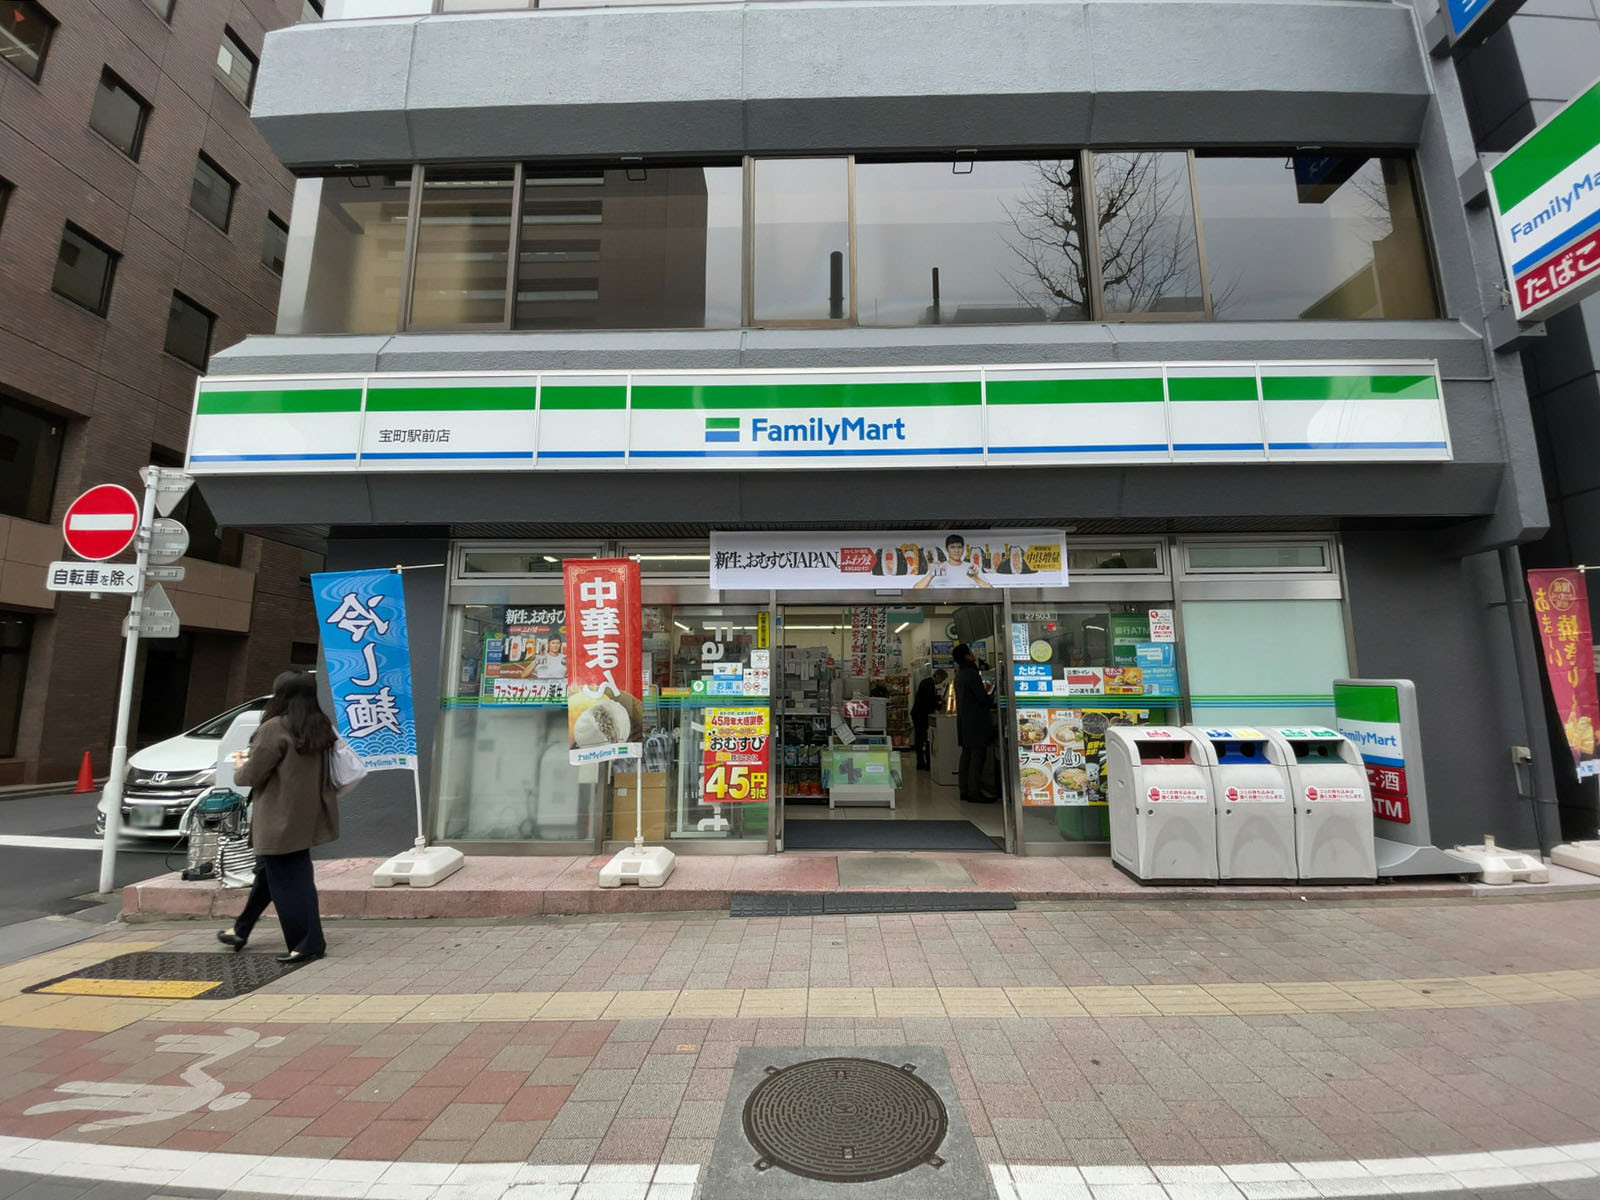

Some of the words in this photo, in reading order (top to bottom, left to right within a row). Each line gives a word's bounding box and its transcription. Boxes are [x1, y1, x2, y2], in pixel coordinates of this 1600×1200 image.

[1524, 241, 1600, 304] たばこ
[379, 428, 451, 443] 宝町駅前店
[752, 417, 906, 446] FamilyMart
[53, 568, 135, 587] 自転車を除く
[1018, 666, 1046, 675] たばこ
[710, 737, 764, 750] おむすび
[1020, 750, 1081, 766] ラーメン巡り
